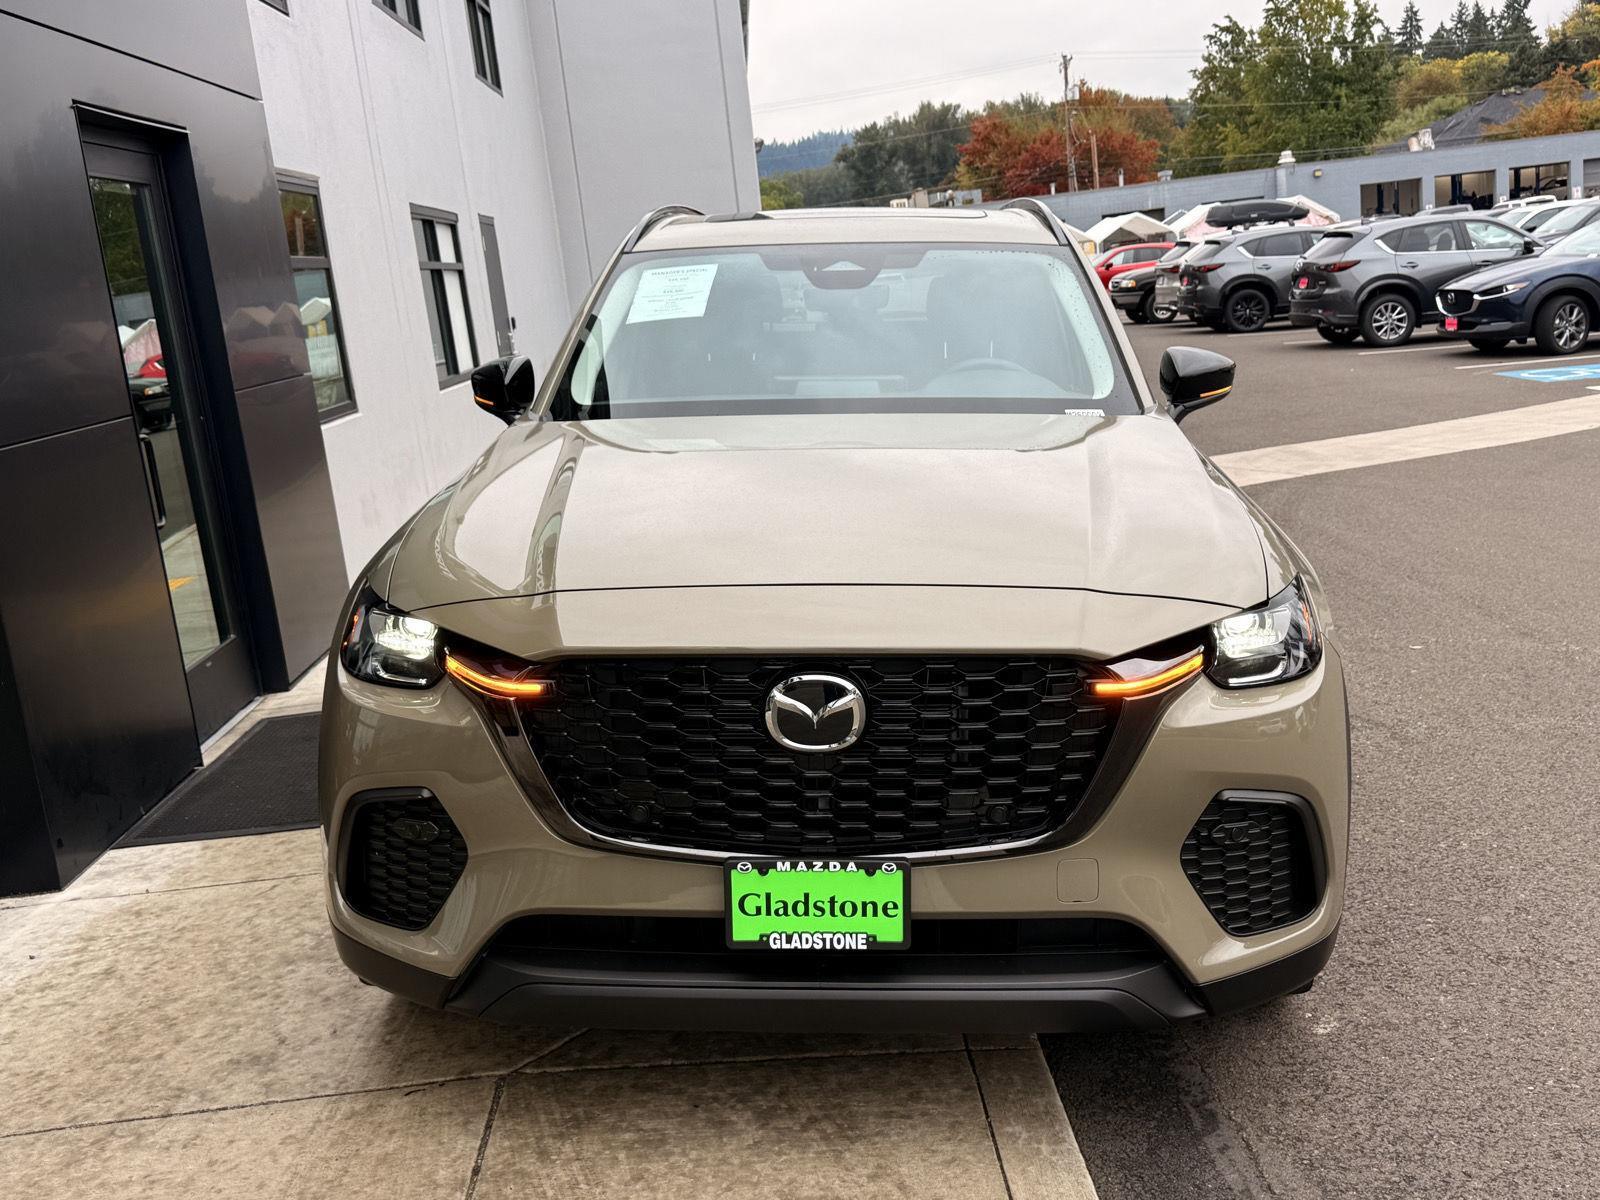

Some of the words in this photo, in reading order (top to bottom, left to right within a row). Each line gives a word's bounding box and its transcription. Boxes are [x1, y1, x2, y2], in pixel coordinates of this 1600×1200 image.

[776, 861, 858, 872] MAZDA
[737, 892, 899, 918] Gladstone
[768, 932, 868, 950] GLADSTONE
